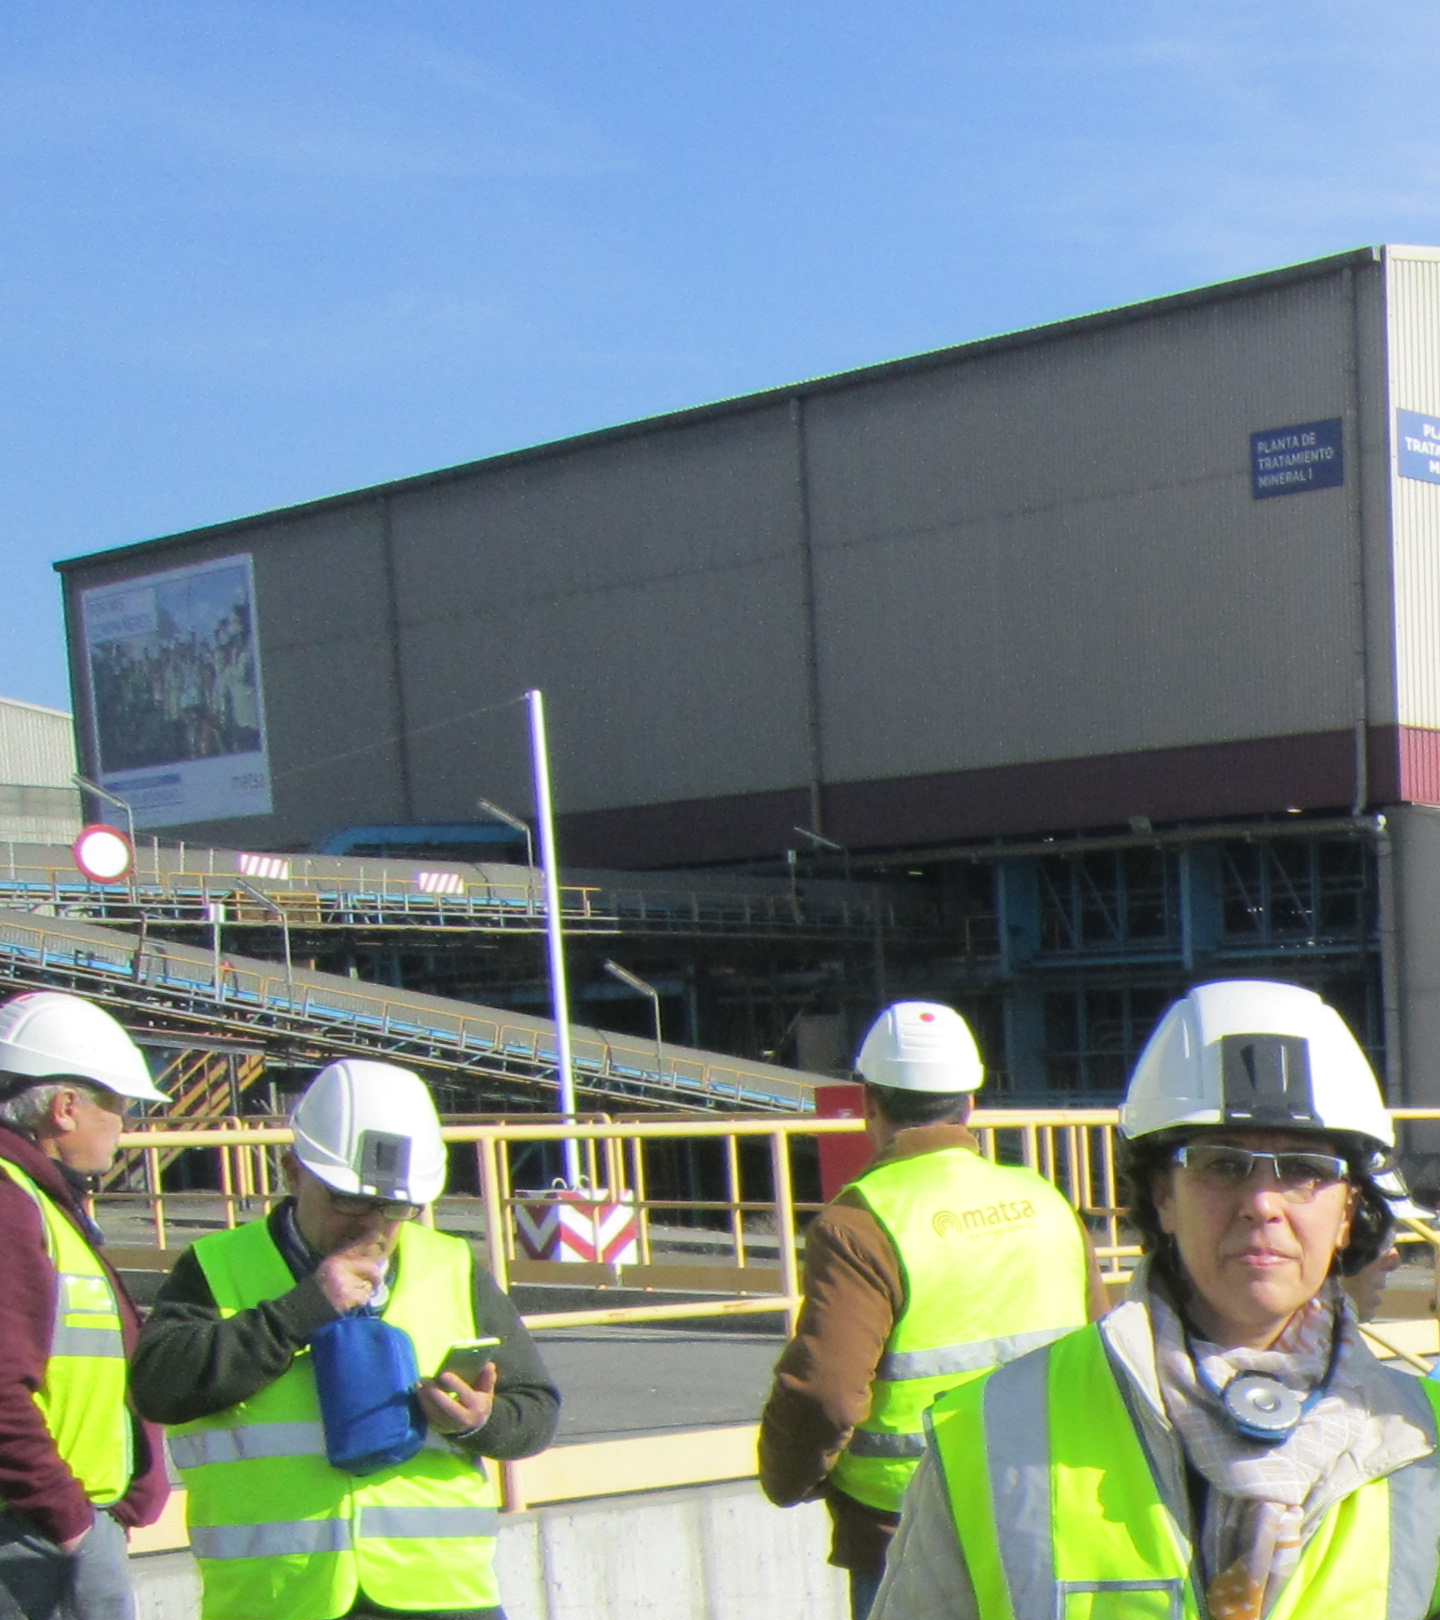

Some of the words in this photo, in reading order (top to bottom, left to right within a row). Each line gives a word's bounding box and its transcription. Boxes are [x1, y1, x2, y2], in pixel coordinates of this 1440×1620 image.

[1257, 435, 1299, 454] PLANTA
[1301, 432, 1316, 446] DE
[1258, 446, 1333, 470] TRATAMIENTO
[1258, 469, 1307, 488] MINERAL
[962, 1200, 1036, 1230] matsa
